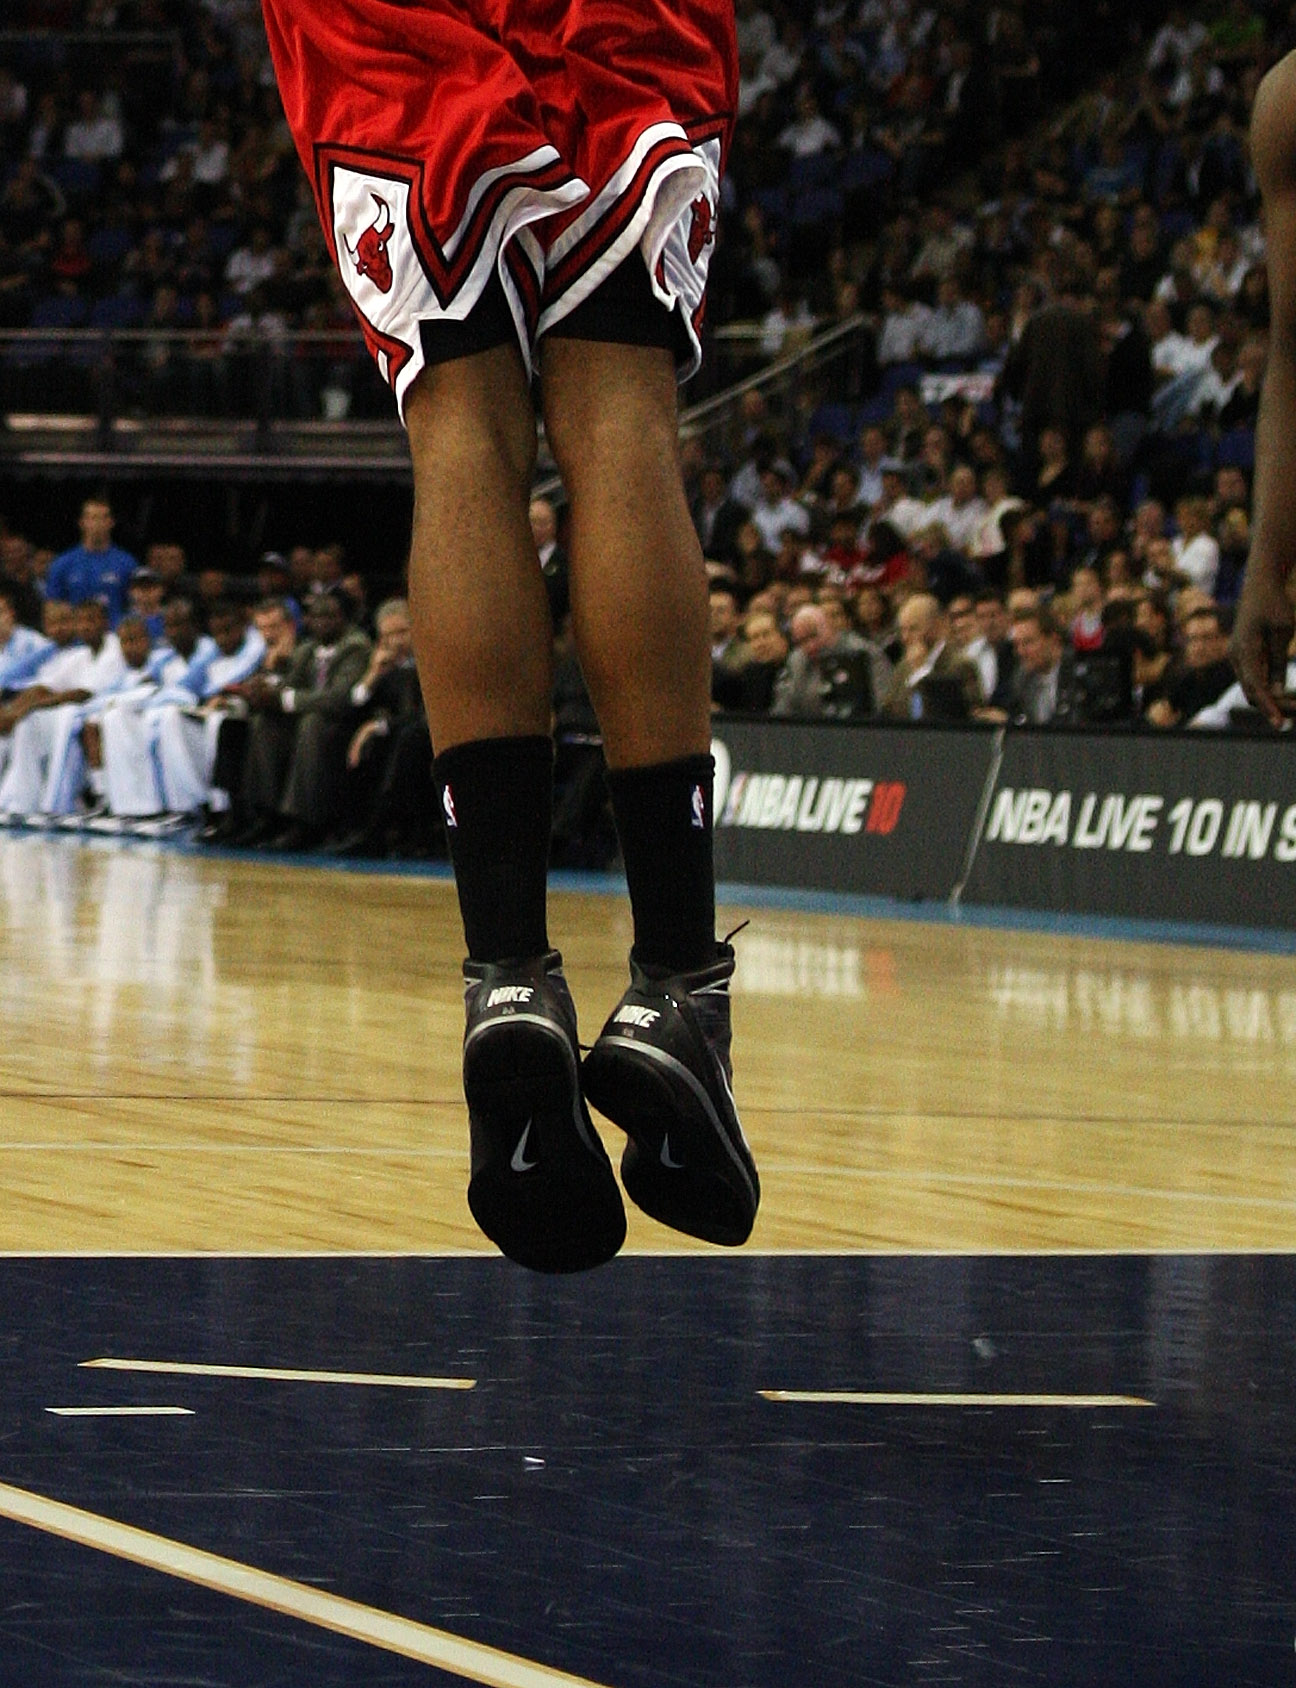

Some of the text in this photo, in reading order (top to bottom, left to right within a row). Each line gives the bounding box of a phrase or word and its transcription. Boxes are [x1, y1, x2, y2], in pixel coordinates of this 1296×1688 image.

[985, 786, 1072, 846] NBA
[1071, 791, 1164, 853] LIVE
[1167, 796, 1224, 857] 10
[1220, 798, 1278, 861] IN
[486, 985, 535, 1008] NIKE
[613, 1004, 662, 1028] NIKE
